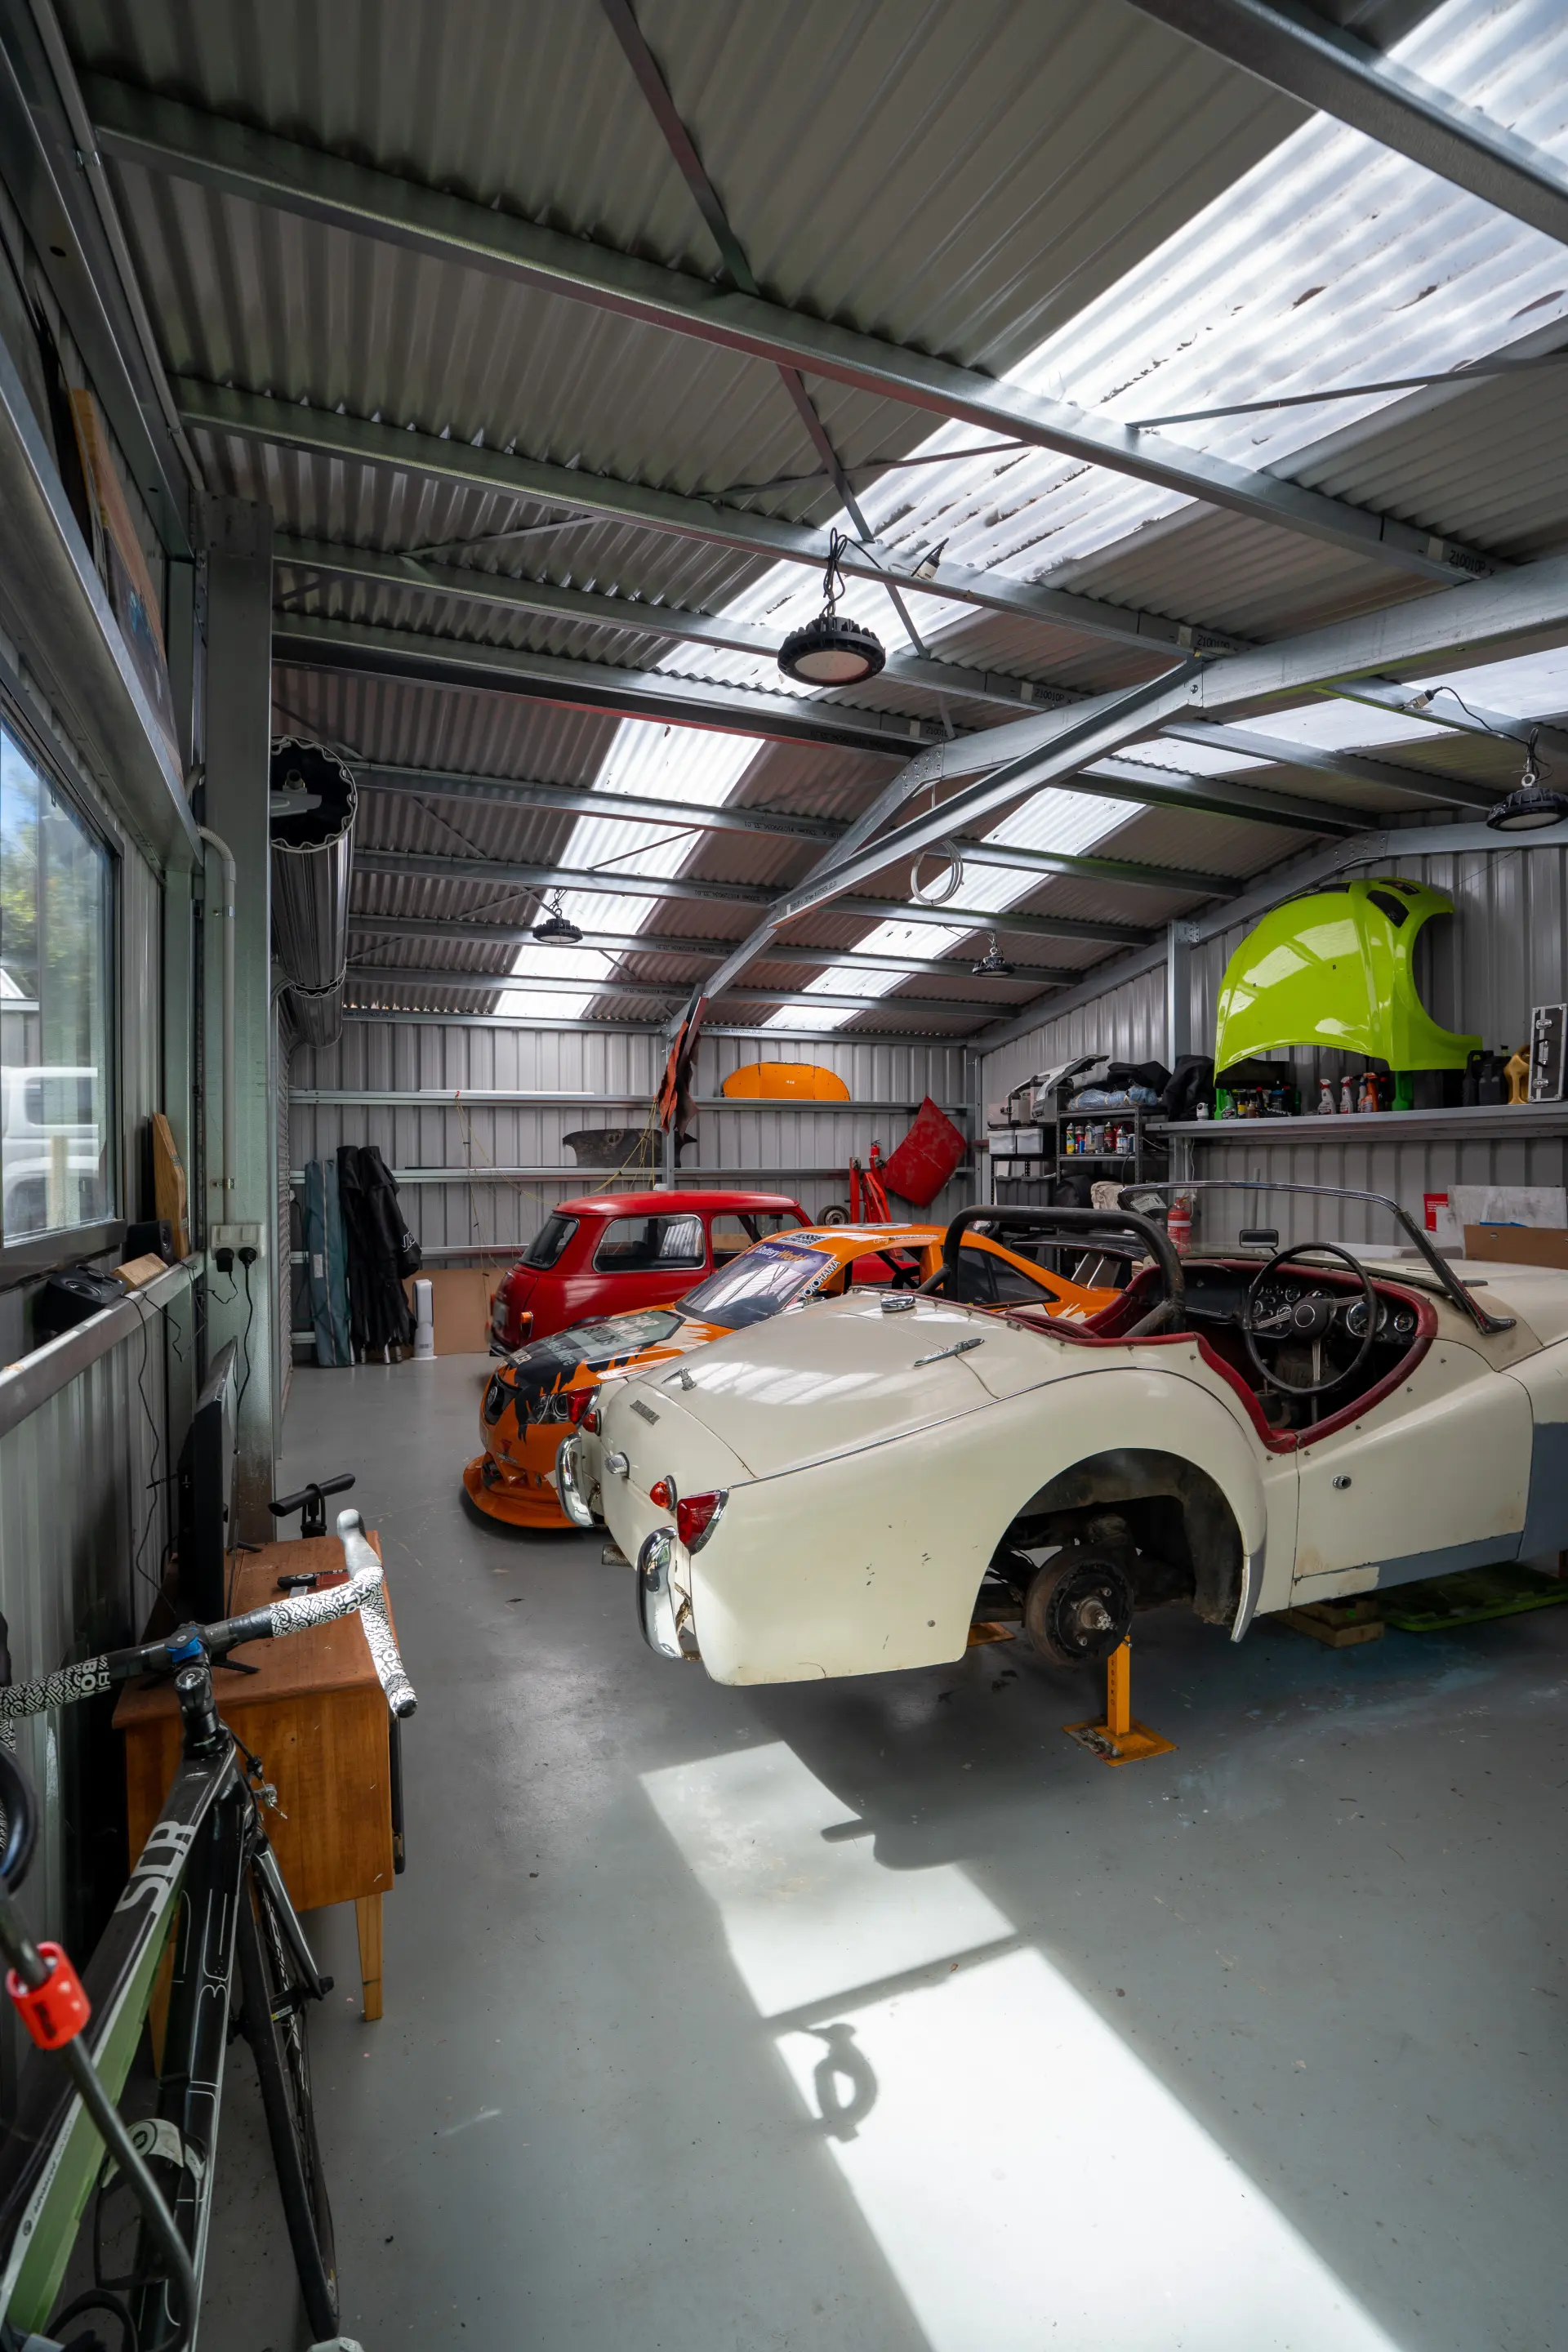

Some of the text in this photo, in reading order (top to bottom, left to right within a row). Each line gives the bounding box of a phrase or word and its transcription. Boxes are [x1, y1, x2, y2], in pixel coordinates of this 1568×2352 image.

[1447, 550, 1486, 573] Z10010P
[1034, 688, 1064, 702] Z10010P
[800, 1259, 841, 1298] YOKOHAMA
[114, 1820, 198, 1916] SCR
